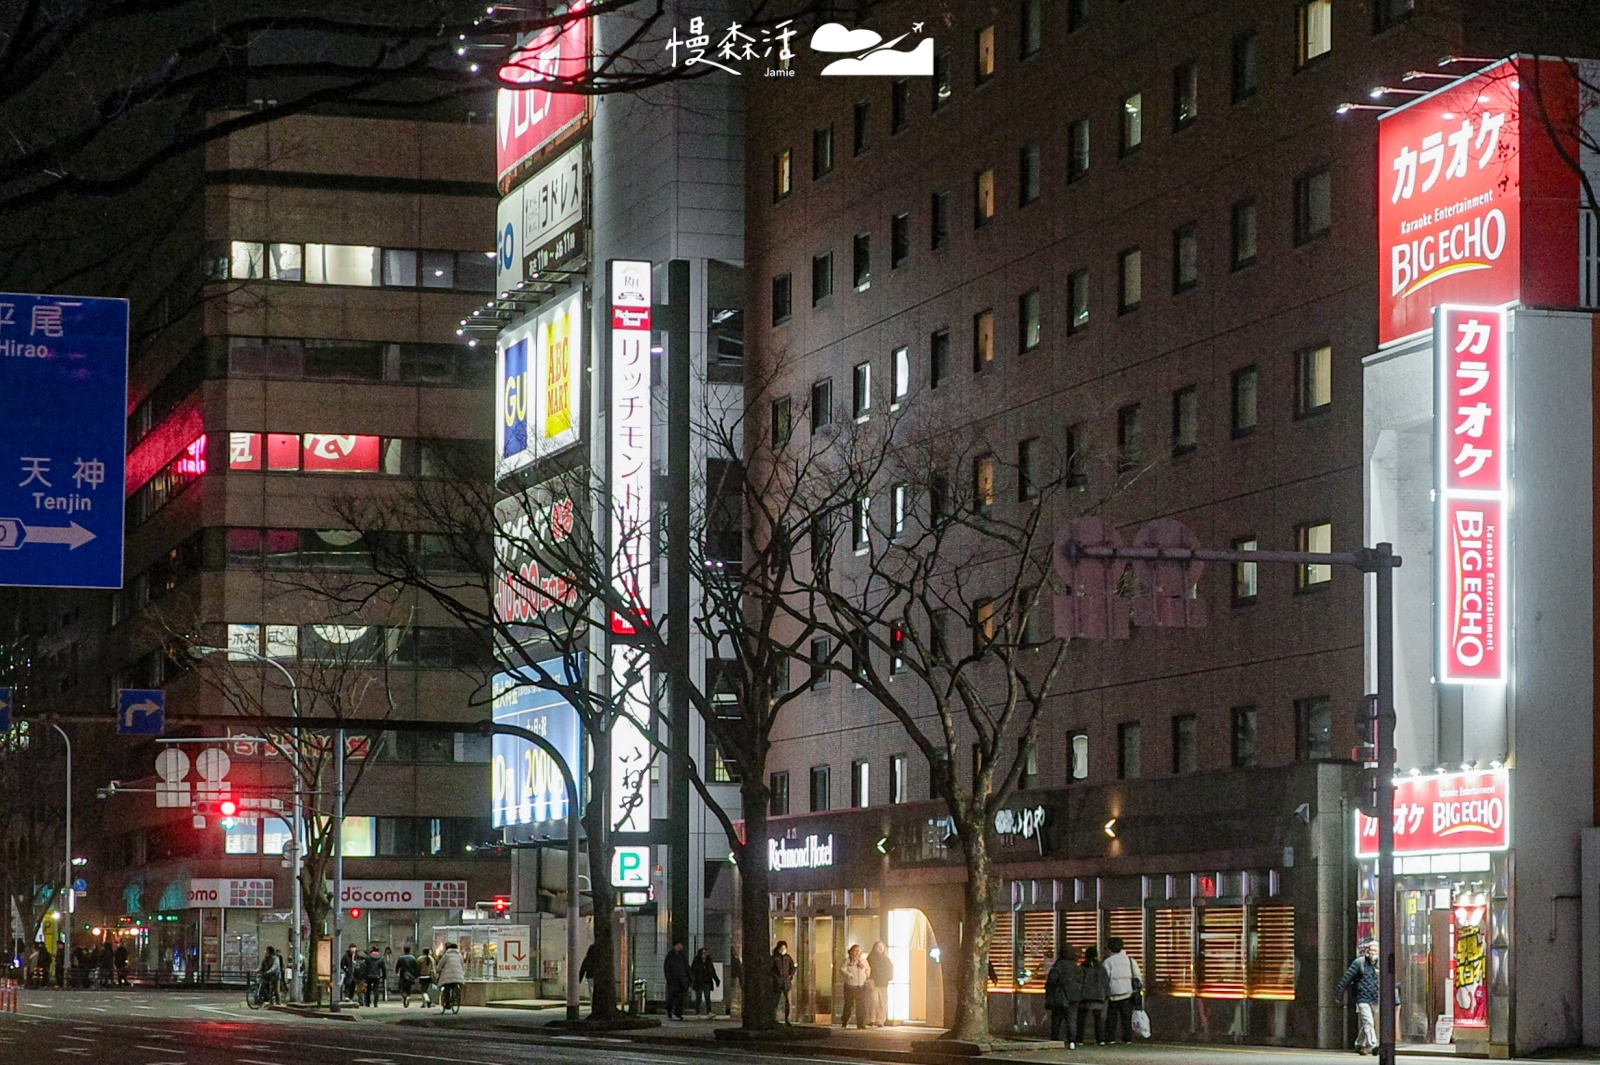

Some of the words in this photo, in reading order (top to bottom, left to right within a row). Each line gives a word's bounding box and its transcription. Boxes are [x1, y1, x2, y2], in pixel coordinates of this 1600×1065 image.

[1391, 111, 1506, 205] カラオケ
[1401, 214, 1433, 235] Karaoke
[1434, 188, 1494, 223] Entertainment
[1391, 235, 1435, 298] BIG
[1438, 208, 1507, 265] ECHO
[0, 340, 48, 358] Hirao
[548, 336, 569, 386] ABC
[504, 371, 528, 427] GU
[547, 381, 568, 417] MART
[1454, 318, 1493, 479] カラオケ
[18, 456, 105, 490] 天神
[32, 491, 92, 514] Tenjin
[1455, 509, 1484, 572] BIG
[1486, 525, 1495, 569] Karaoke
[1455, 577, 1484, 667] ECHO
[1486, 572, 1495, 651] Entertainment
[1432, 801, 1461, 834] BIG
[1462, 797, 1504, 829] ECHO
[619, 852, 641, 881] P
[767, 835, 809, 872] Richmond
[810, 832, 833, 869] Hotel
[341, 886, 412, 902] docomo
